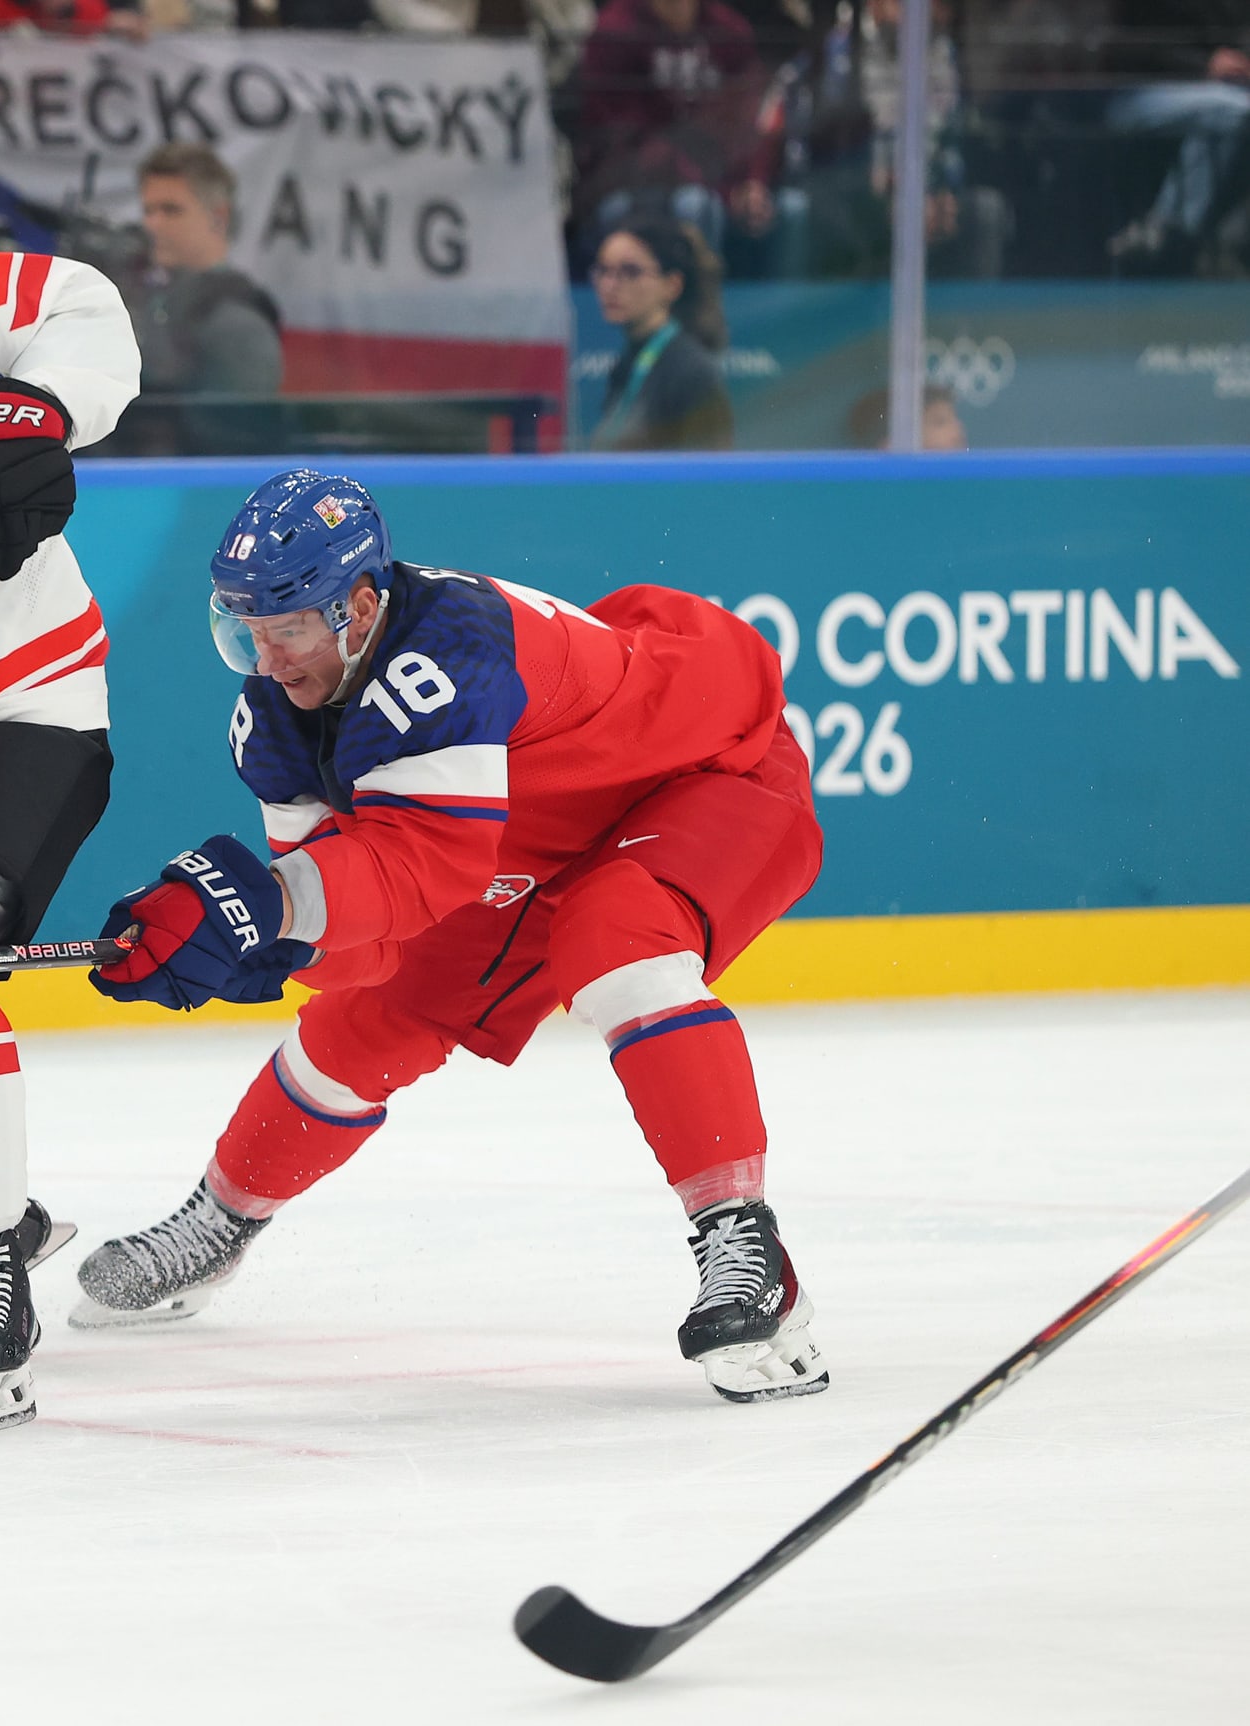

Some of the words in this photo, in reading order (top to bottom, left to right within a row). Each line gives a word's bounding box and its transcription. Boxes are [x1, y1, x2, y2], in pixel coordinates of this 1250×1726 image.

[261, 173, 469, 277] ANG
[228, 533, 257, 561] 18
[341, 535, 375, 566] BAUER
[816, 586, 1241, 688] CORTINA
[359, 650, 457, 735] 18
[783, 701, 913, 797] 26
[29, 941, 97, 958] BAUER
